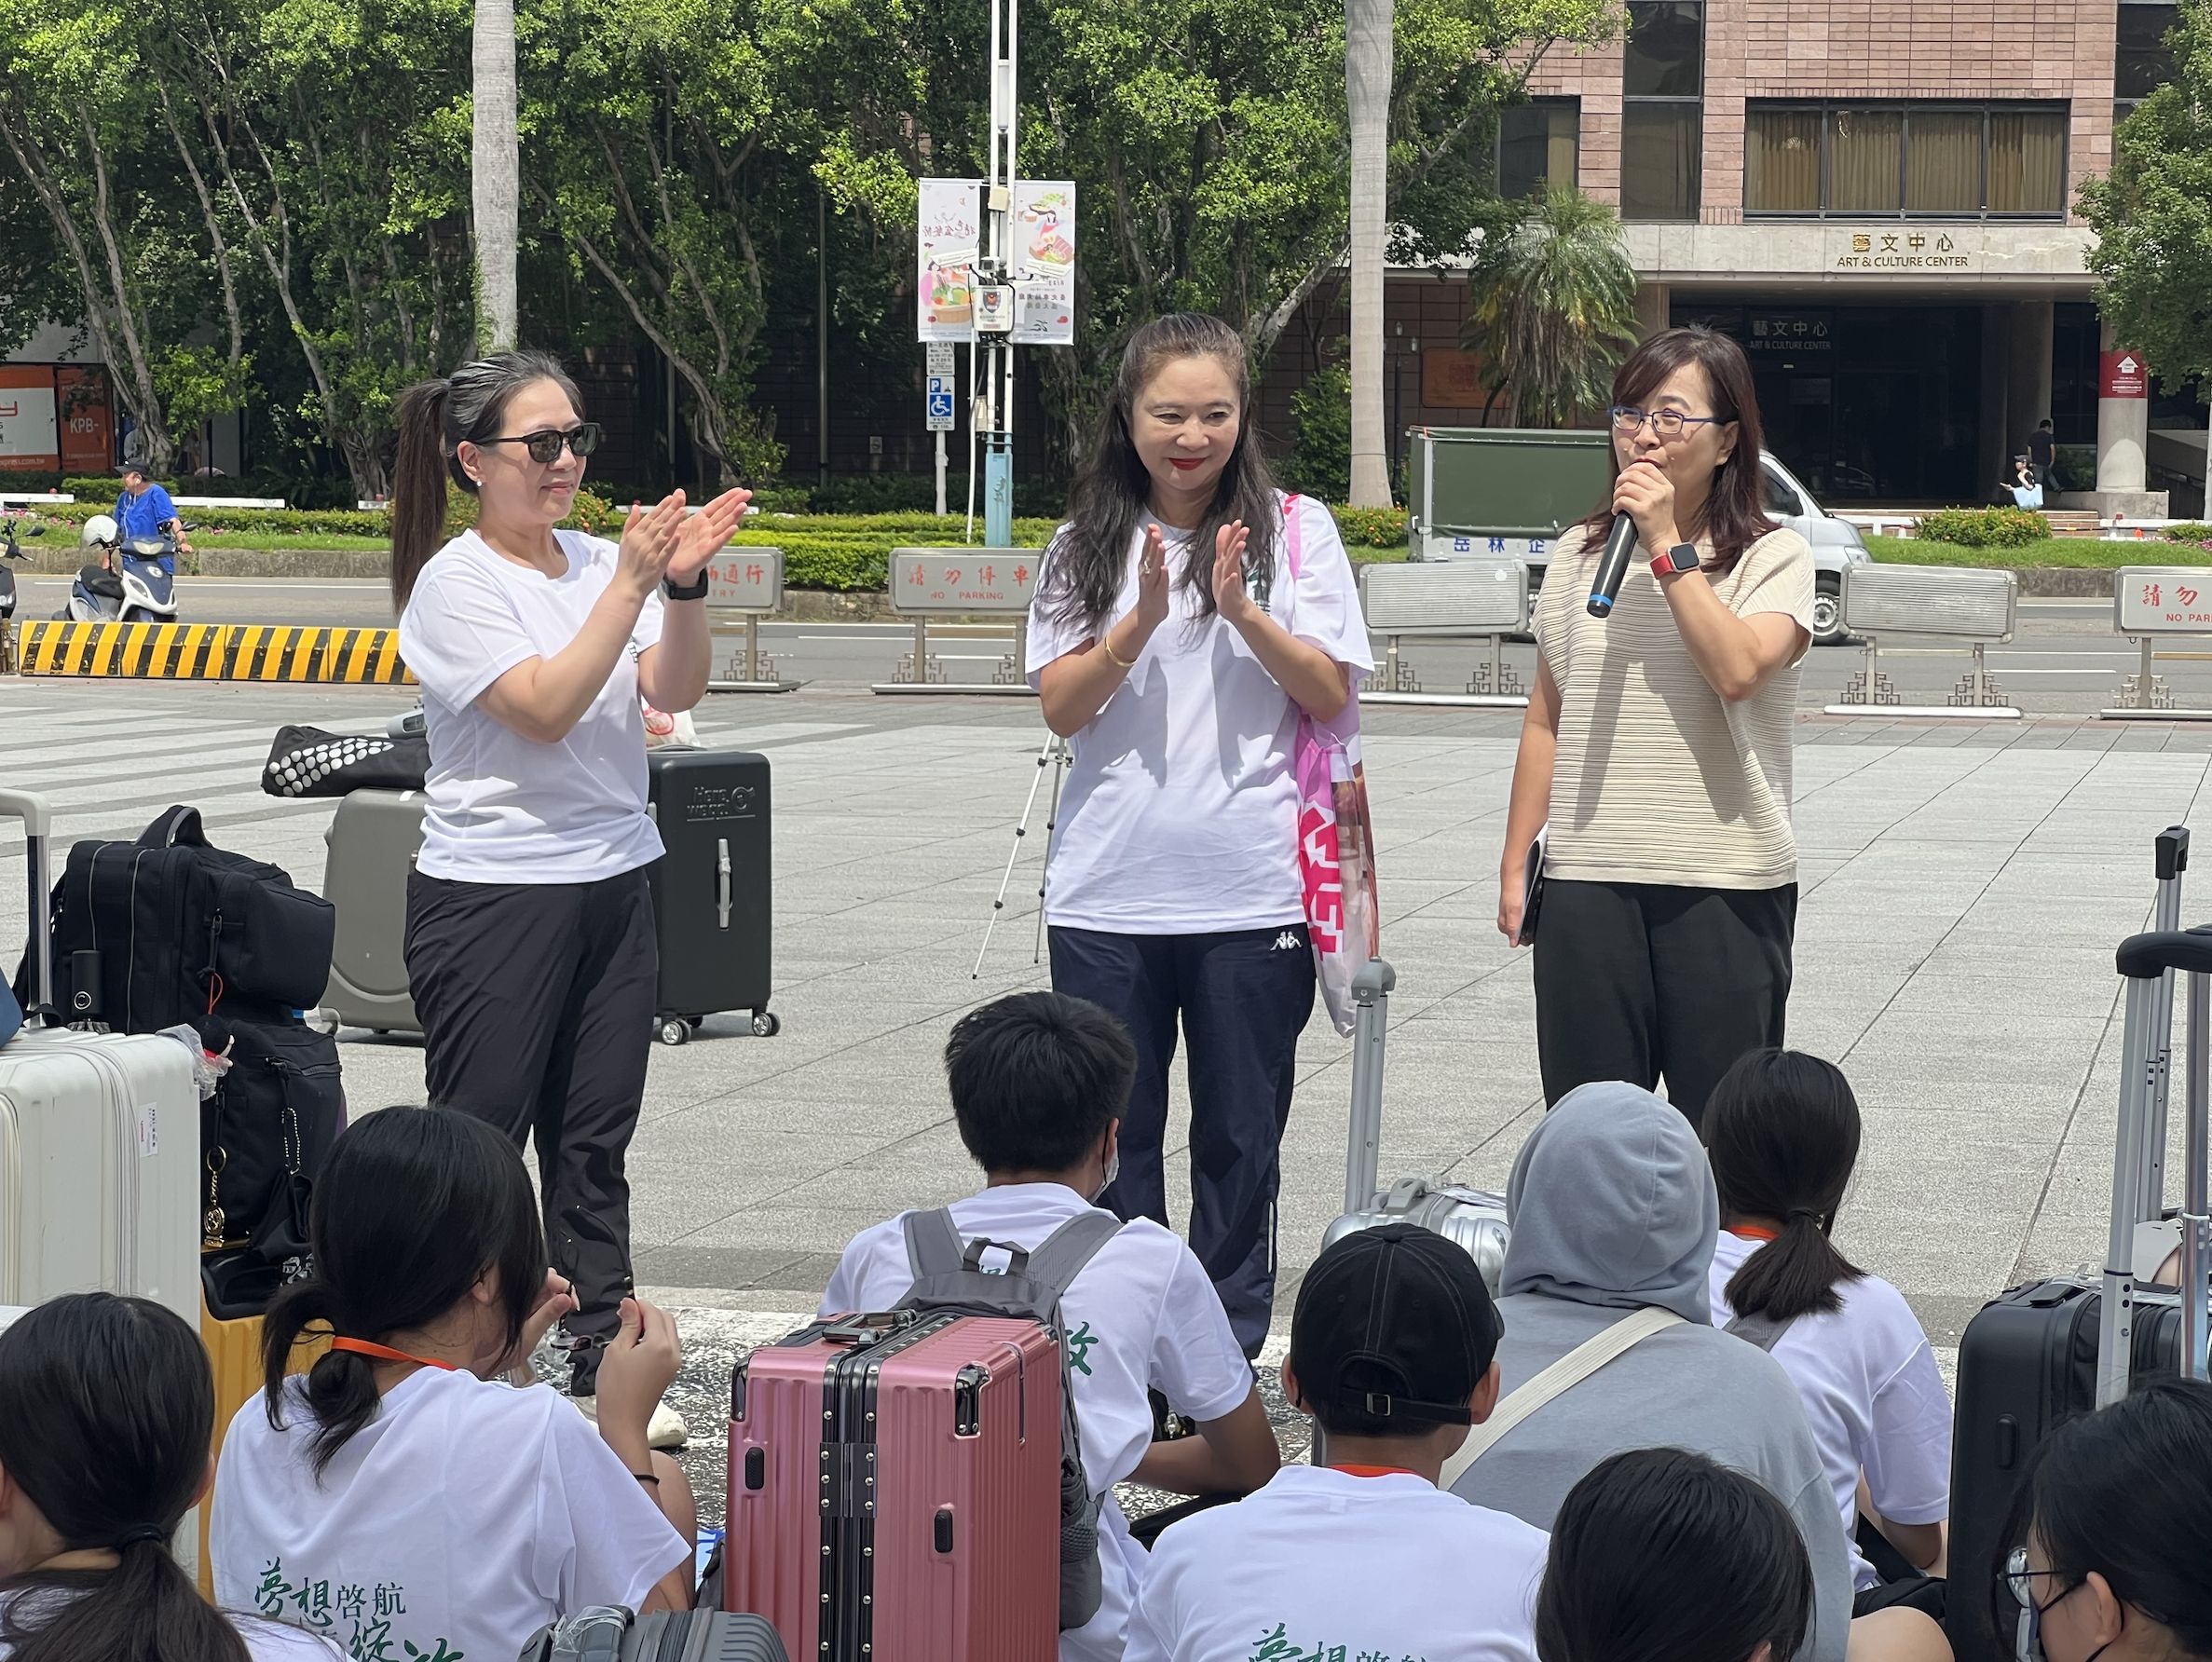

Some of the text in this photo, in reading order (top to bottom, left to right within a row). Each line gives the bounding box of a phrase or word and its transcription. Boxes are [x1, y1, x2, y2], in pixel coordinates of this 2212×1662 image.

[1852, 233, 1954, 252] 藝文中心
[1837, 256, 1968, 267] ART & CULTURE CENTER
[1753, 320, 1828, 336] 藝文中心
[1750, 340, 1763, 350] ART
[1771, 340, 1803, 350] CULTURE
[1804, 340, 1832, 350] CENTER
[908, 564, 1030, 587] 請勿停車
[959, 592, 1004, 600] PARKING
[2142, 583, 2199, 606] 請勿
[2165, 613, 2212, 622] NO PAR
